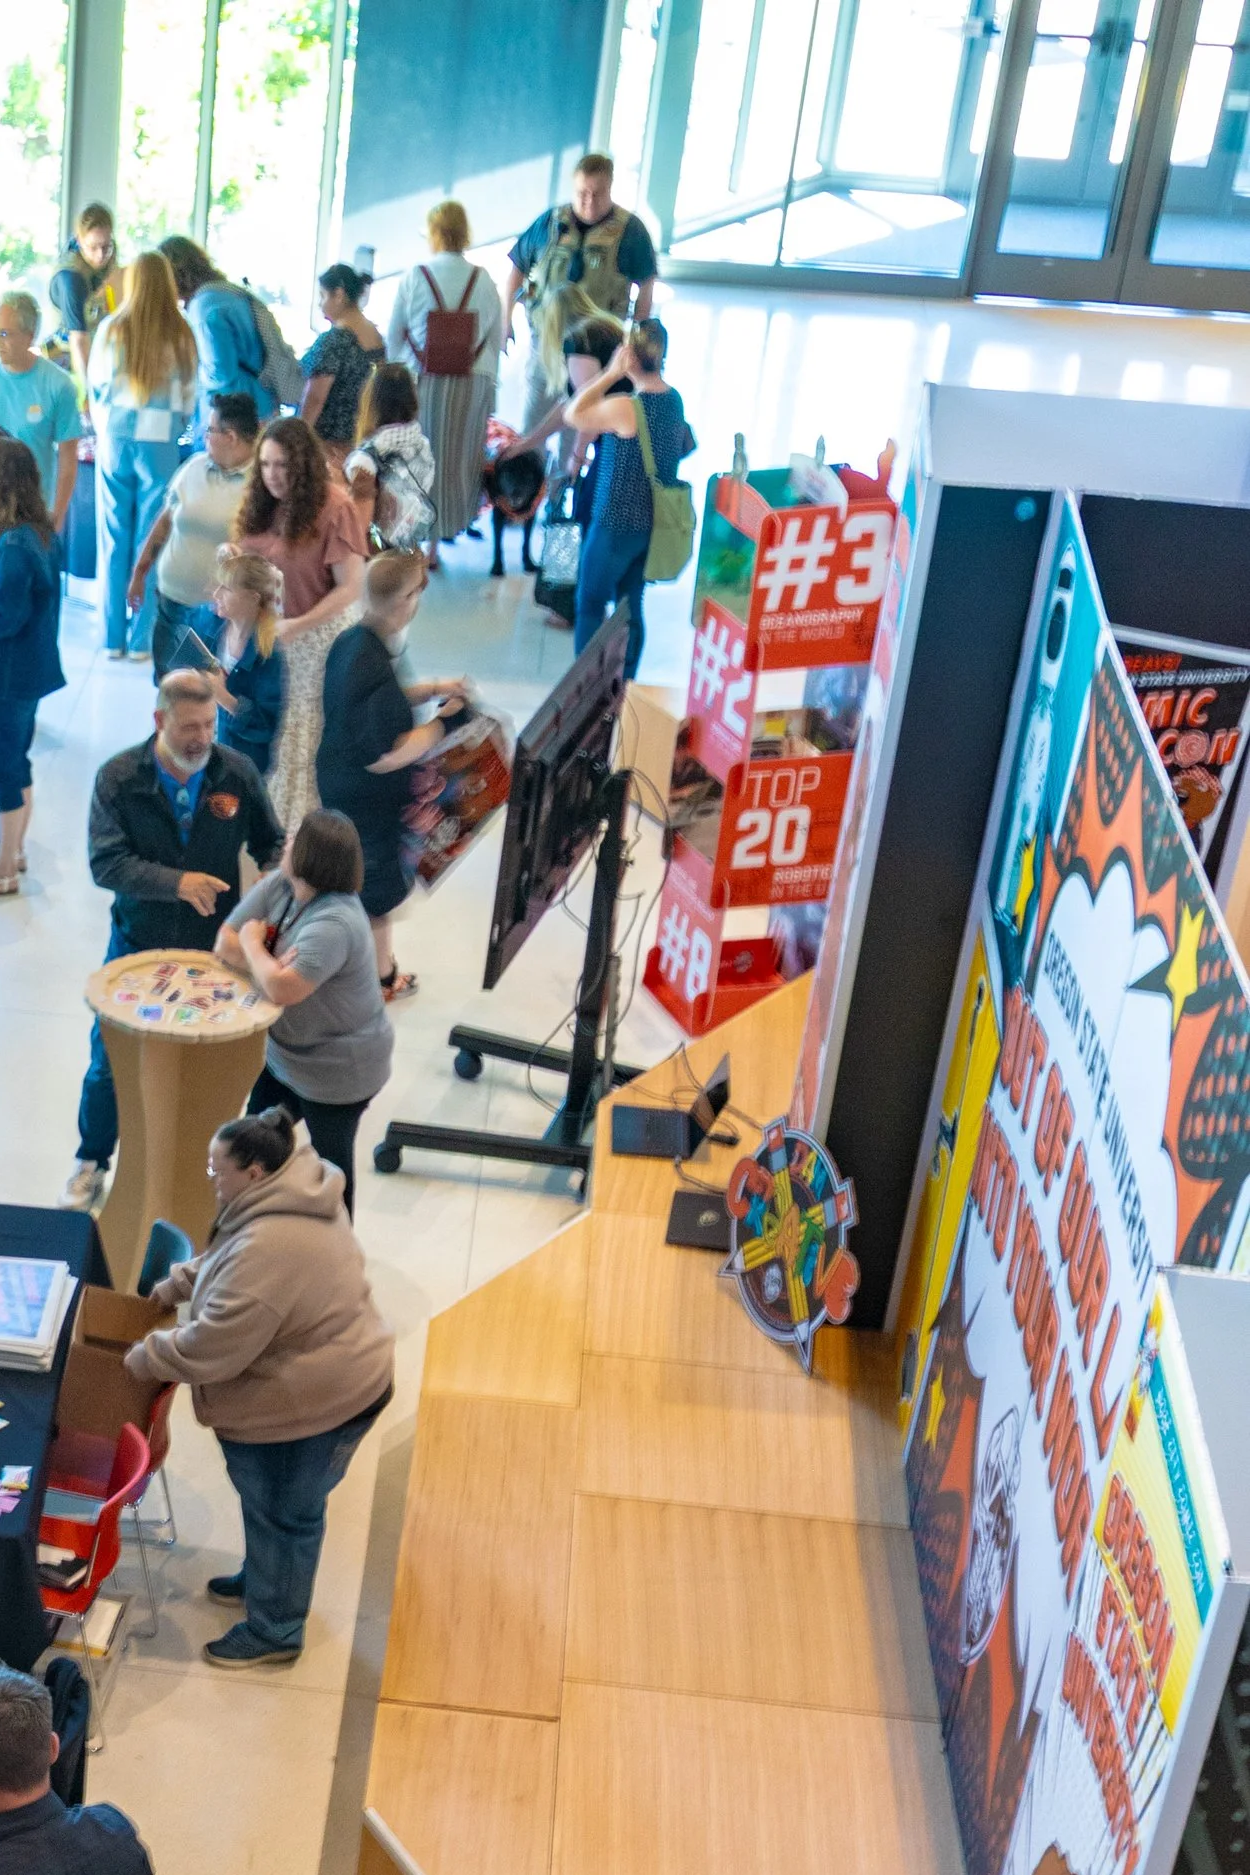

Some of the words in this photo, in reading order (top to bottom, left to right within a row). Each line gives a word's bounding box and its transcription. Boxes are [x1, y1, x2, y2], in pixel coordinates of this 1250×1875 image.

[758, 510, 896, 612] #3
[1140, 688, 1217, 728] MIC
[730, 804, 813, 870] 20
[747, 766, 822, 808] TOP
[659, 902, 713, 1001] #8
[1044, 929, 1085, 1038] OREGON
[1079, 1006, 1111, 1120] STATE
[1034, 1059, 1076, 1197] OF
[1058, 1137, 1111, 1371] OUR
[1005, 1181, 1061, 1421] YOUR
[1102, 1472, 1177, 1698] OREGON
[1096, 1571, 1148, 1751] STATE
